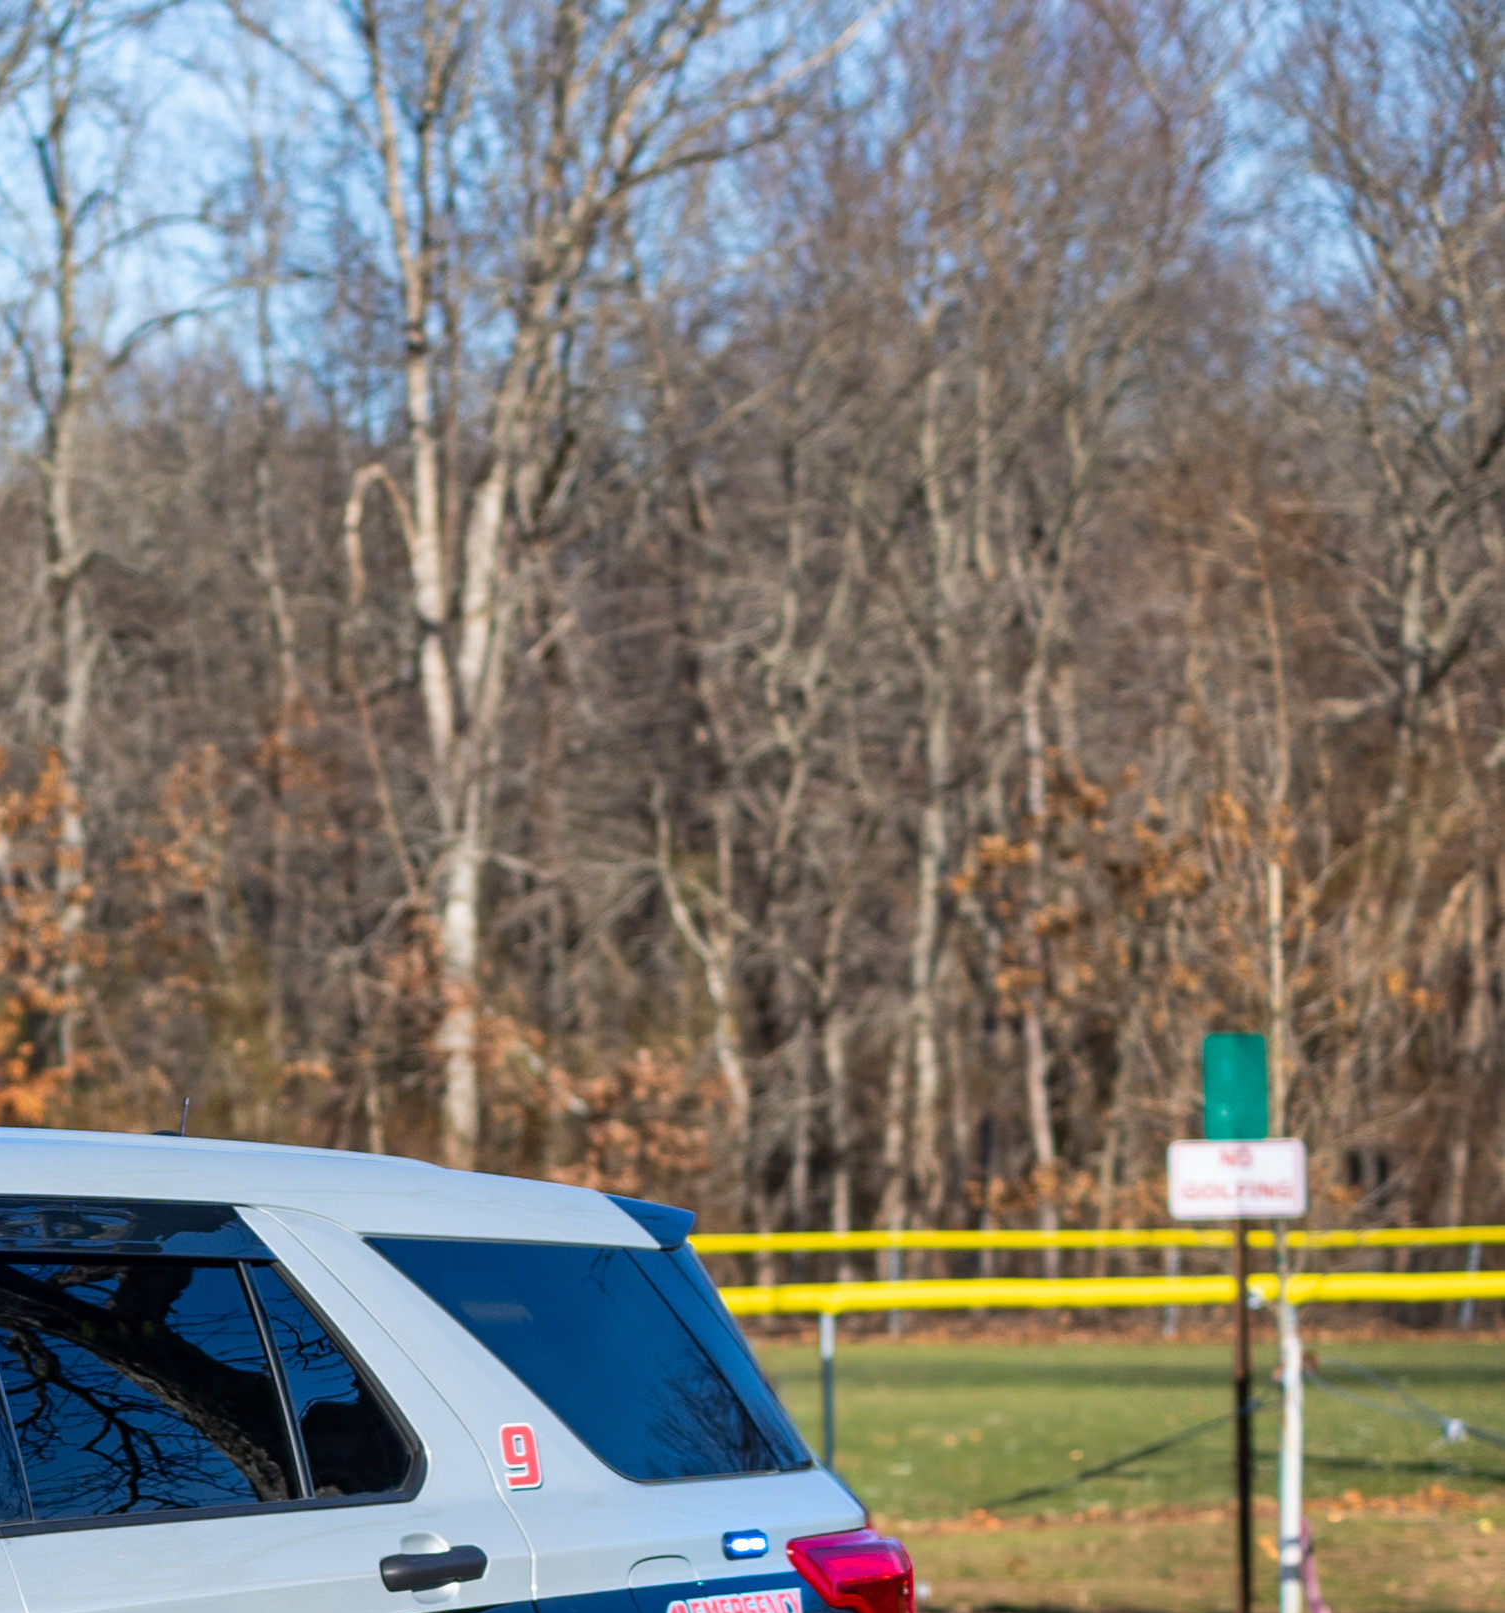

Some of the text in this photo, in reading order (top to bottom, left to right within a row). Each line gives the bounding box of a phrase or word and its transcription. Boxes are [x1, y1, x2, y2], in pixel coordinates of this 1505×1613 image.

[1220, 1147, 1254, 1166] NO
[1183, 1181, 1293, 1198] GOLFING
[499, 1422, 543, 1491] 9
